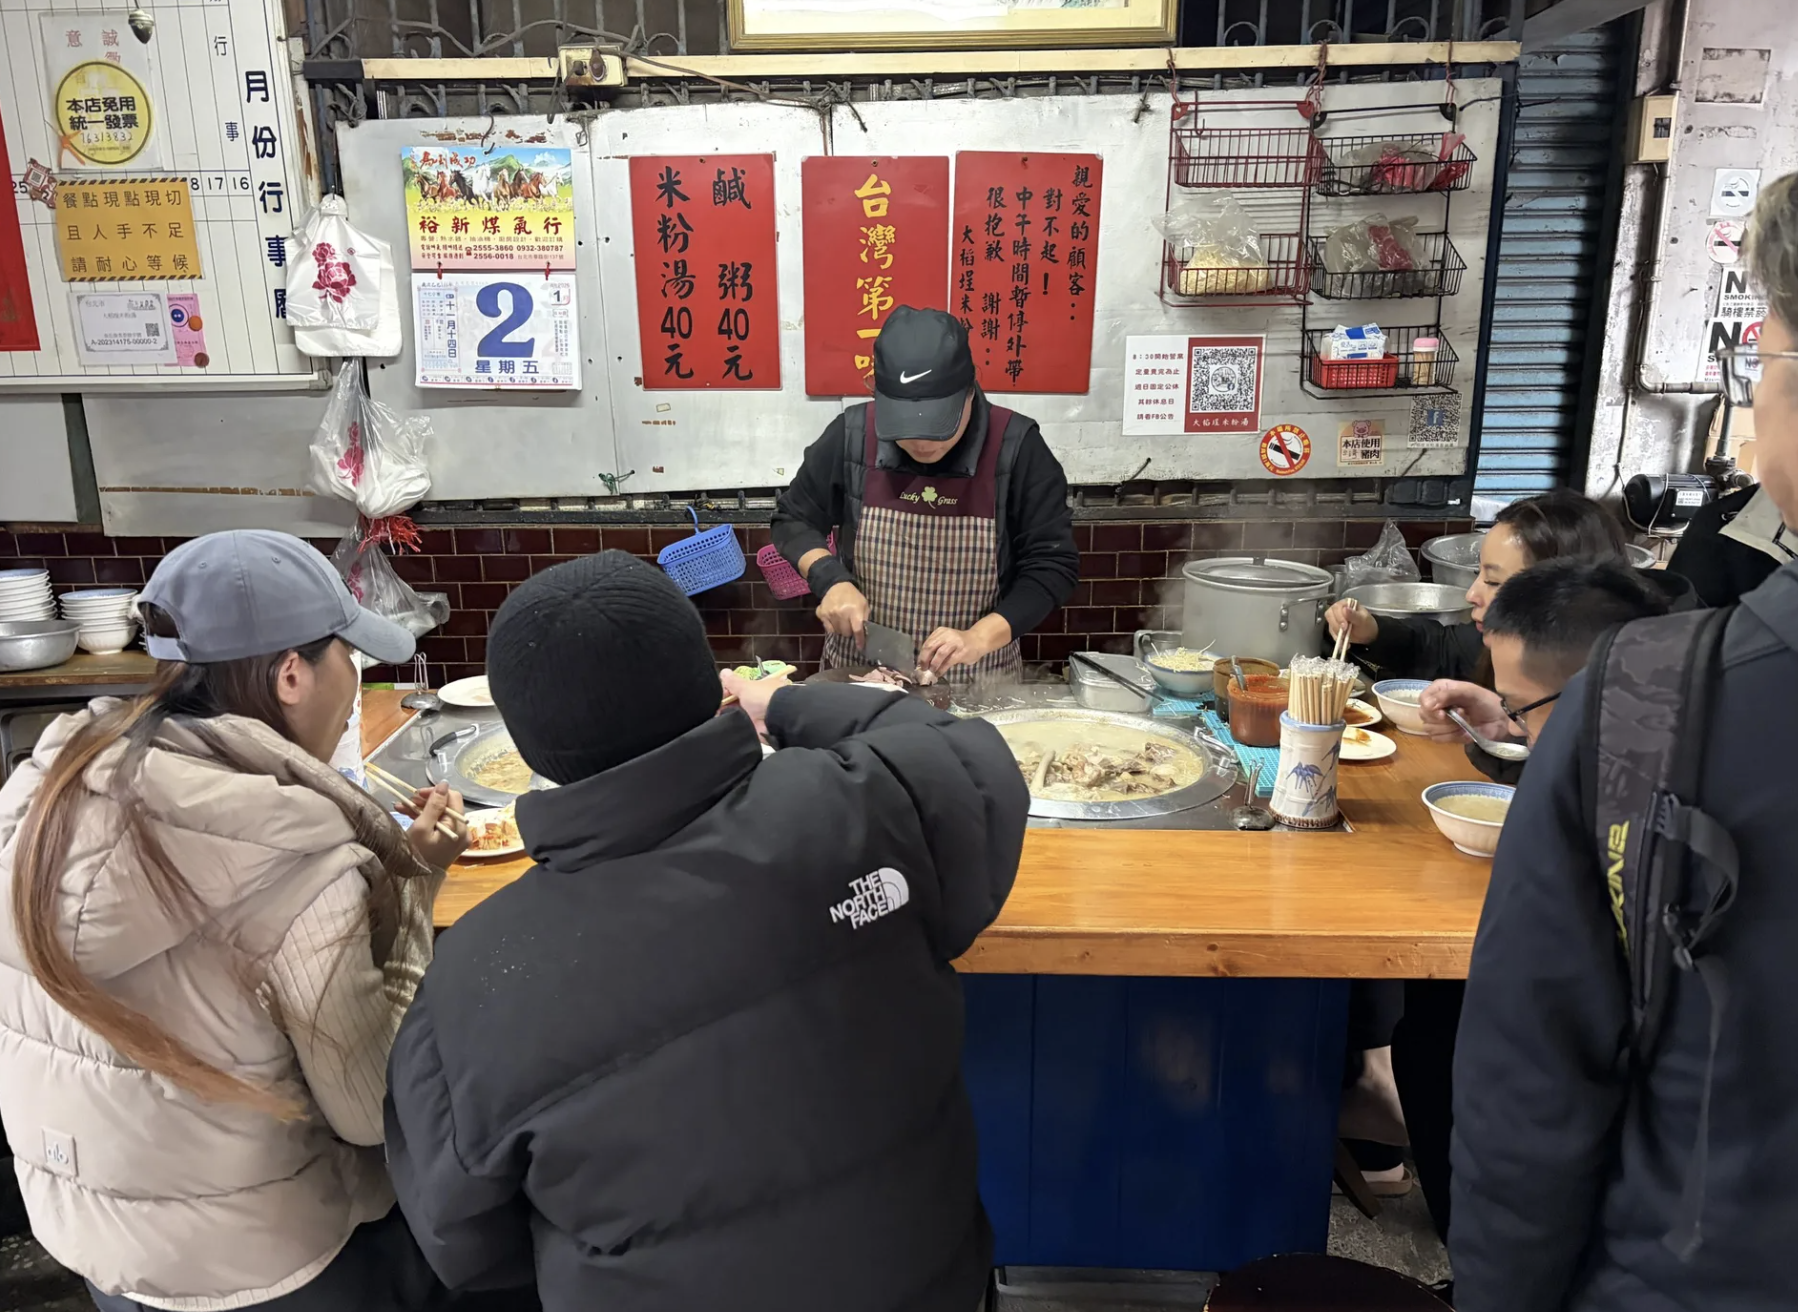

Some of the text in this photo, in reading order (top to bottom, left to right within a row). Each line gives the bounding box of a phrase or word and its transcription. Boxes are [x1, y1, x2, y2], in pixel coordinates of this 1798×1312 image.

[66, 97, 136, 113] 本店免用
[69, 114, 138, 131] 統一發票
[190, 177, 200, 191] 8
[207, 177, 224, 190] 17
[233, 176, 250, 190] 16
[63, 190, 182, 208] 餐點現點現切
[67, 222, 184, 240] 且人手不足
[419, 216, 563, 235] 裕新煤氣行
[71, 254, 189, 273] 請耐心等候
[476, 282, 535, 358] 2
[475, 360, 539, 374] 星期五
[1342, 438, 1381, 449] 本店使用
[1361, 450, 1380, 460] 豬肉
[899, 492, 958, 506] Lucky Grass
[848, 870, 881, 896] THE
[829, 885, 886, 923] NORTH
[850, 900, 889, 930] FACE
